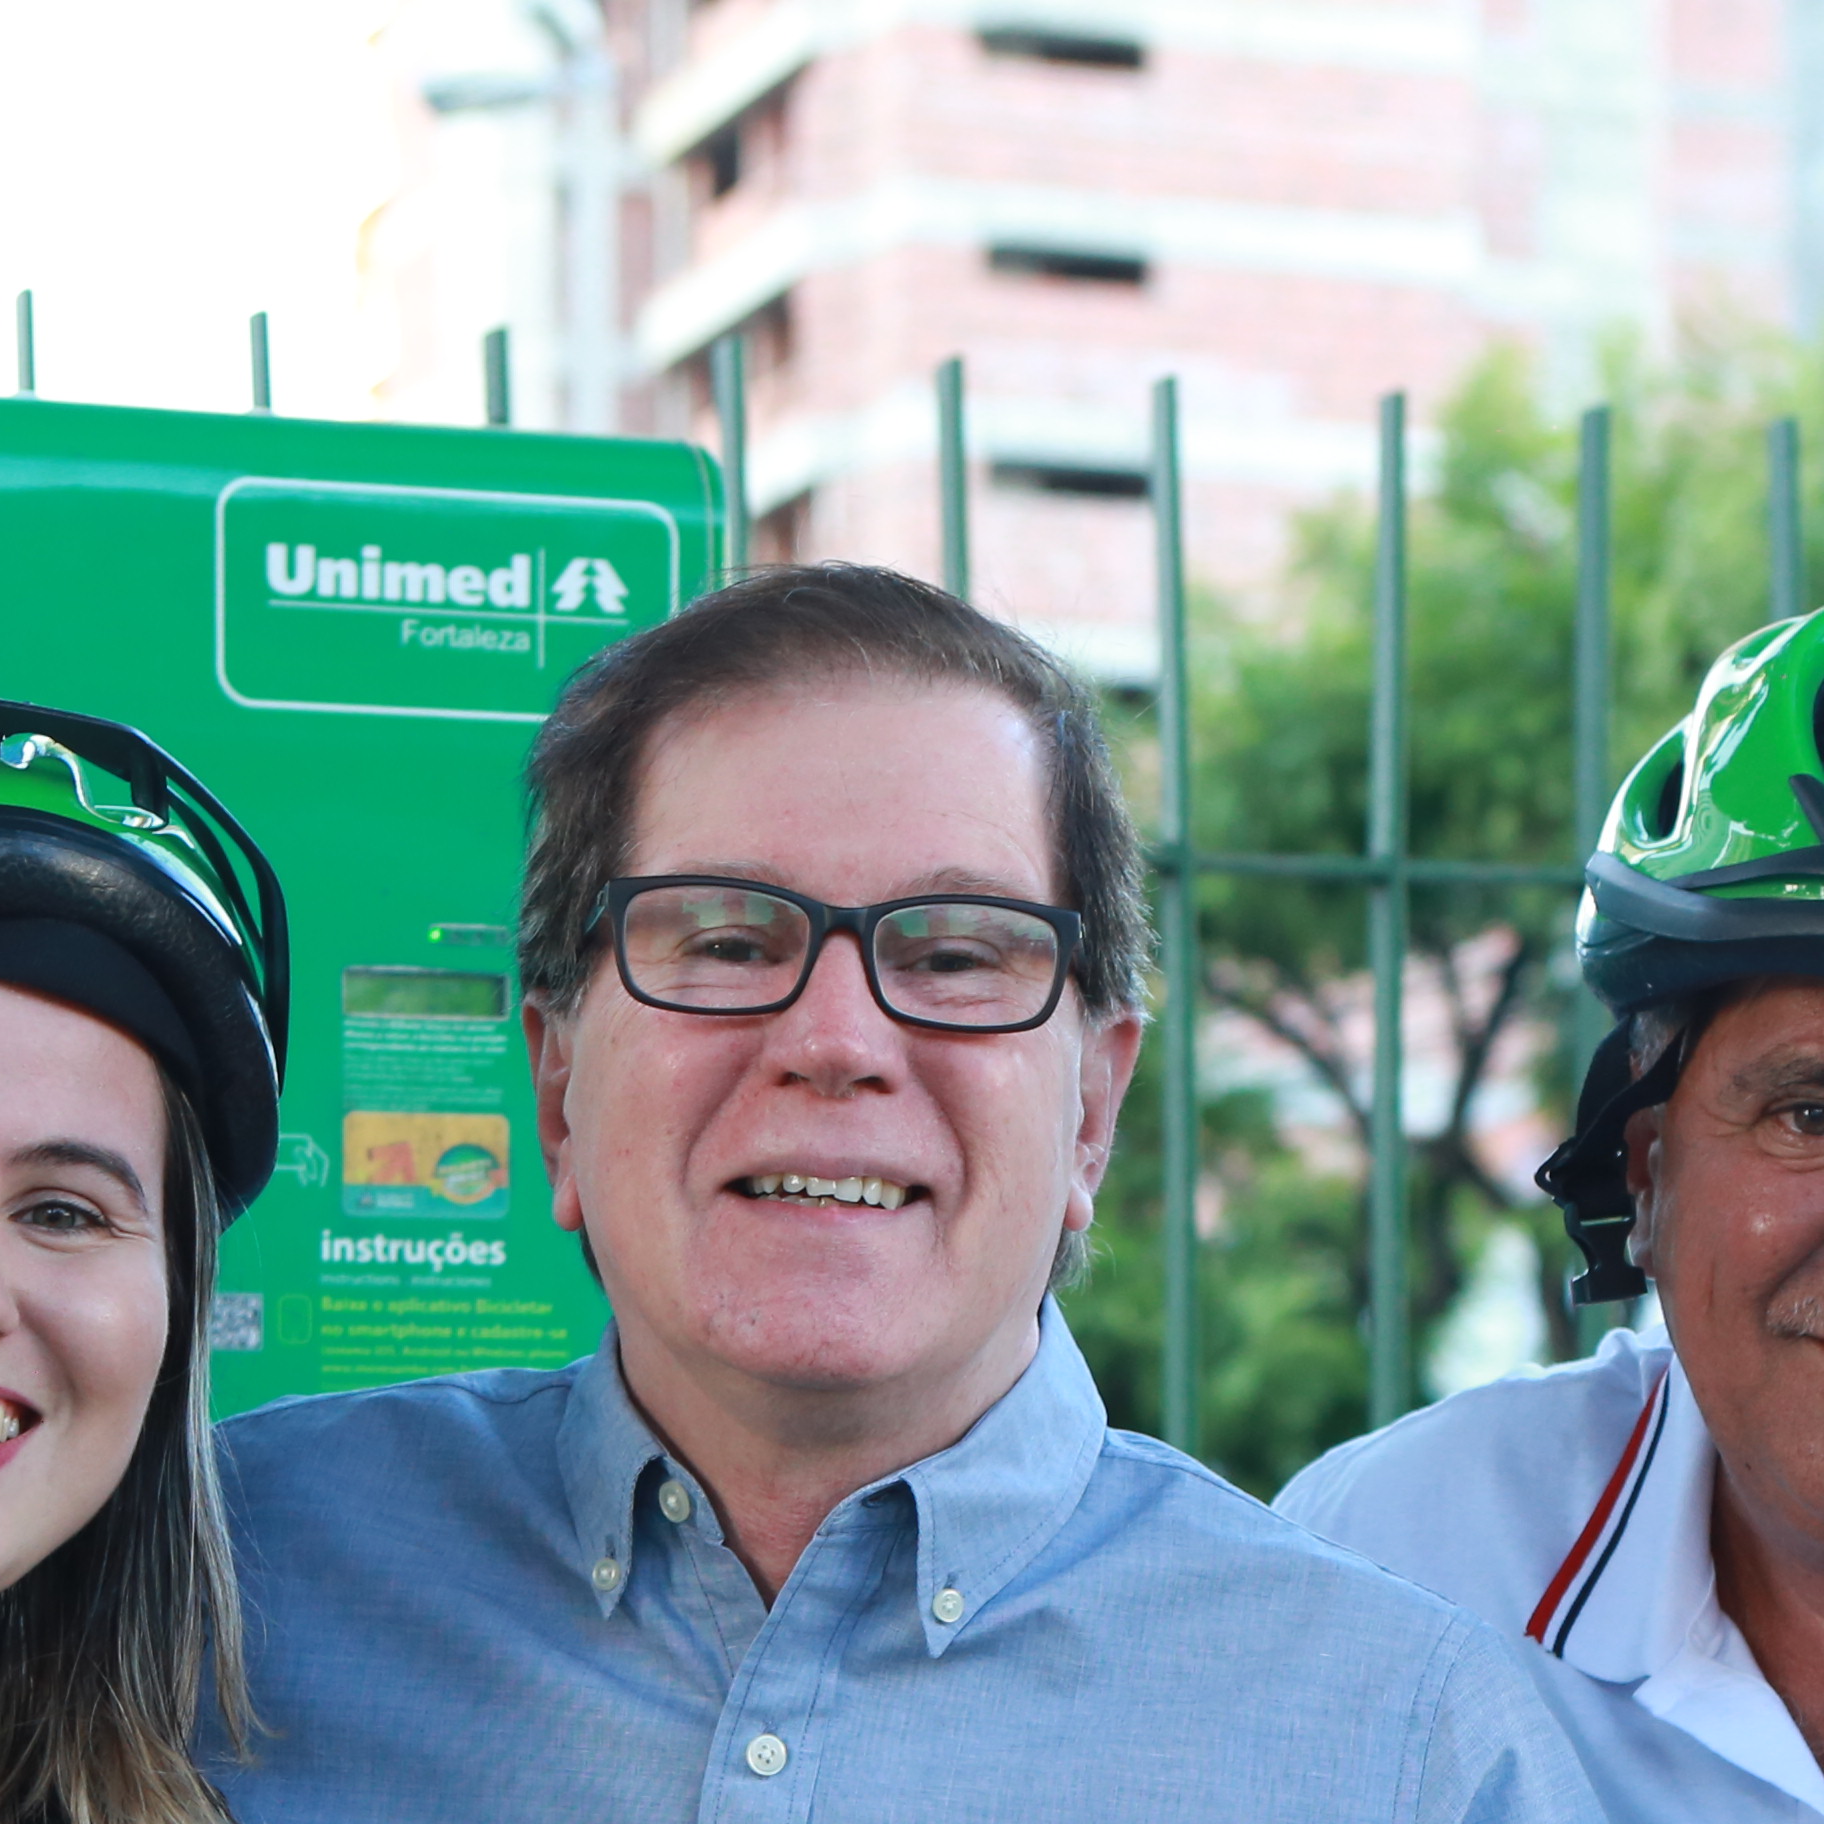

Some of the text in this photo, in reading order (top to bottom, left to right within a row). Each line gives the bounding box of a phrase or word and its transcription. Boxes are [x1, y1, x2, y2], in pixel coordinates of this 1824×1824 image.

[267, 542, 531, 609] Unimed
[401, 619, 530, 652] Fortaleza
[320, 1230, 507, 1271] instruções
